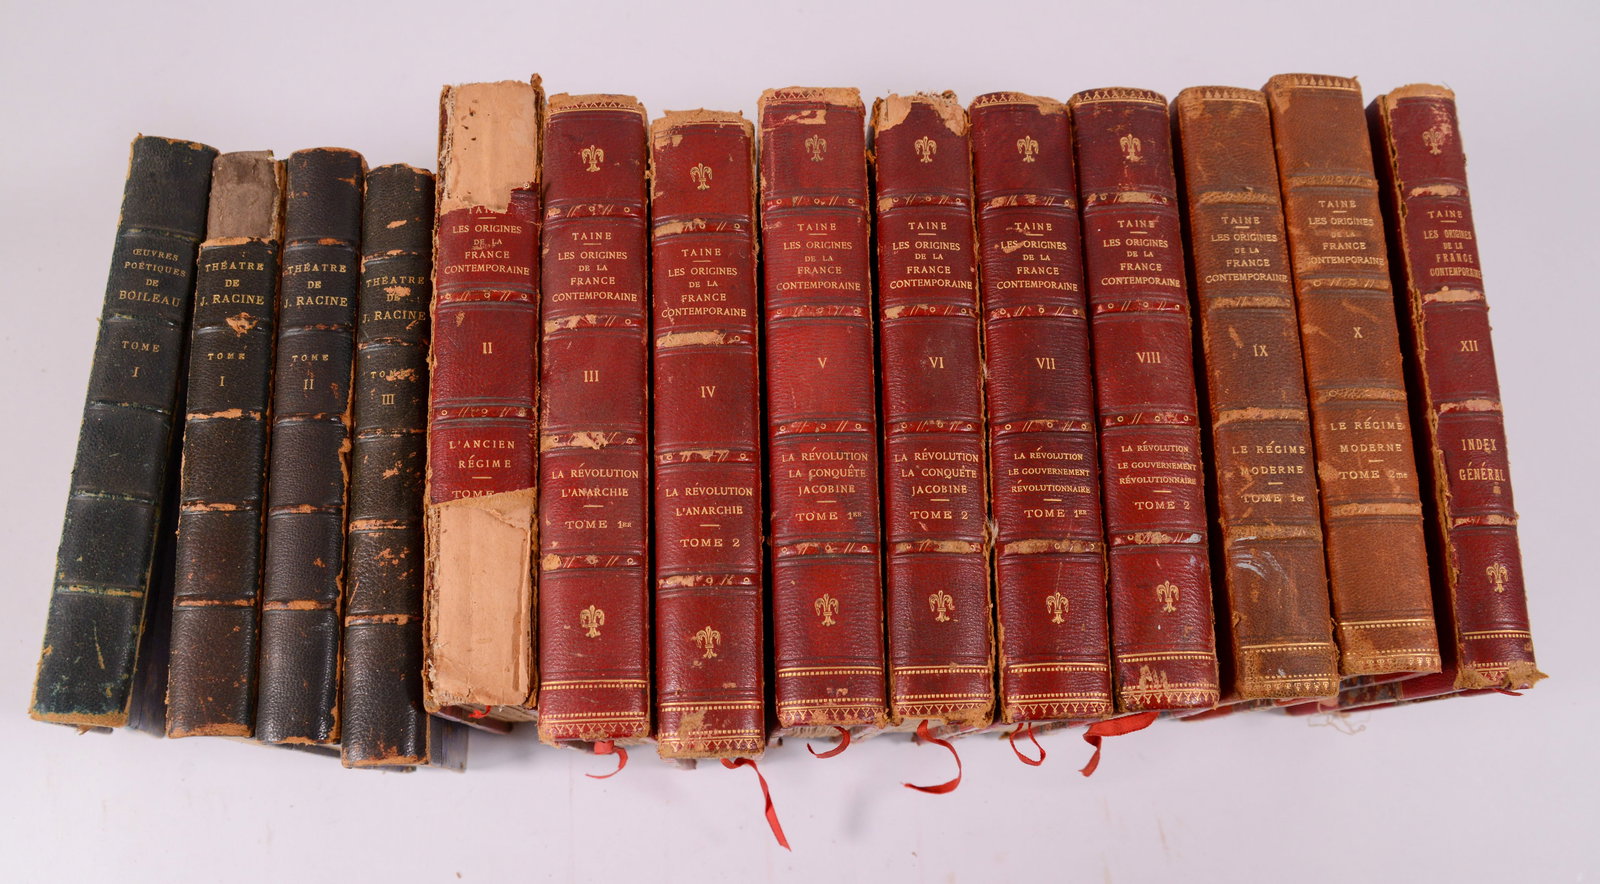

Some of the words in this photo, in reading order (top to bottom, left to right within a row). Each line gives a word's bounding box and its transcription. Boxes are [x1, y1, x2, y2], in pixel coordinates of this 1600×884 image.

[1318, 200, 1357, 208] TAINE
[1427, 210, 1463, 219] TAINE
[1117, 220, 1155, 228] TAINE
[1221, 216, 1261, 225] TAINE
[1308, 217, 1327, 225] LES
[1331, 217, 1374, 227] ORIGINES
[452, 225, 469, 234] LES
[474, 224, 522, 234] ORIGINES
[797, 223, 837, 232] TAINE
[908, 222, 947, 230] TAINE
[1014, 222, 1052, 231] TAINE
[572, 232, 612, 240] TAINE
[1211, 234, 1230, 242] LES
[1233, 233, 1278, 242] ORIGINES
[1424, 230, 1439, 239] LES
[1444, 230, 1472, 239] ORIGINES
[474, 238, 485, 246] DE
[784, 241, 800, 250] LES
[806, 241, 852, 249] ORIGINES
[892, 242, 909, 250] LES
[915, 241, 960, 251] ORIGINES
[1001, 241, 1018, 249] LES
[1023, 241, 1067, 250] ORIGINES
[1103, 239, 1121, 248] LES
[1126, 239, 1168, 248] ORIGINES
[1322, 242, 1367, 250] FRANCE
[132, 249, 179, 261] ŒUVRES
[465, 251, 510, 259] FRANCE
[558, 252, 574, 261] LES
[682, 248, 721, 257] TAINE
[1226, 259, 1271, 267] FRANCE
[1436, 253, 1473, 263] FRANCE
[124, 261, 187, 278] POÉTIQUES
[205, 261, 264, 272] THÉATRE
[288, 262, 347, 274] THÉATRE
[444, 264, 530, 276] CONTEMPORAINE
[797, 266, 842, 275] FRANCE
[907, 266, 951, 274] FRANCE
[1017, 266, 1060, 275] FRANCE
[1120, 263, 1162, 271] FRANCE
[668, 268, 685, 277] LES
[691, 267, 737, 276] ORIGINES
[146, 279, 159, 287] DE
[366, 275, 425, 287] THÉATRE
[570, 277, 615, 285] FRANCE
[1101, 277, 1181, 288] CONTEMPORAINE
[1206, 273, 1288, 283] CONTEMPORAINE
[225, 279, 240, 288] DE
[308, 281, 322, 289] DE
[776, 281, 861, 291] CONTEMPORAINE
[890, 279, 972, 290] CONTEMPORAINE
[997, 280, 1078, 292] CONTEMPORAINE
[119, 290, 181, 307] BOILEAU
[200, 296, 208, 306] J.
[213, 294, 264, 305] RACINE
[284, 299, 292, 308] J.
[296, 296, 348, 306] RACINE
[386, 294, 400, 302] DE
[552, 292, 637, 302] CONTEMPORAINE
[681, 293, 726, 303] FRANCE
[363, 314, 370, 323] J.
[374, 310, 426, 321] RACINE
[662, 307, 746, 318] CONTEMPORAINE
[1354, 327, 1363, 338] X
[122, 340, 160, 352] TOME
[482, 342, 493, 354] II
[1253, 345, 1268, 356] IX
[1460, 340, 1478, 352] XII
[818, 358, 827, 368] V
[929, 356, 944, 369] VI
[1136, 352, 1161, 364] VIII
[1036, 358, 1056, 369] VII
[132, 366, 140, 378] I
[584, 370, 599, 382] III
[220, 376, 225, 386] I
[303, 378, 314, 390] II
[700, 386, 716, 398] IV
[382, 394, 395, 405] III
[1330, 422, 1347, 431] LE
[1355, 417, 1404, 430] RÉGIME
[449, 440, 515, 449] L'ANCIEN
[1121, 445, 1133, 453] LA
[1137, 441, 1189, 453] RÉVOLUTION
[1232, 445, 1248, 454] LE
[1256, 441, 1306, 454] RÉGIME
[1340, 444, 1402, 453] MODERNE
[1461, 439, 1497, 451] INDEX
[782, 454, 795, 463] LA
[801, 447, 868, 461] RÉVOLUTION
[895, 454, 907, 462] LA
[914, 448, 979, 463] RÉVOLUTION
[1030, 446, 1083, 460] RÉVOLUTION
[458, 455, 511, 468] RÉGIME
[1131, 462, 1197, 471] GOUVERNEMENT
[552, 471, 564, 479] LA
[570, 463, 639, 479] RÉVOLUTION
[789, 470, 802, 478] LA
[809, 464, 866, 480] CONQUÊTE
[902, 469, 914, 477] LA
[922, 466, 977, 479] CONQUÊTE
[1022, 468, 1090, 477] GOUVERNEMENT
[1241, 466, 1304, 475] MODERNE
[1339, 471, 1380, 480] TOME
[1459, 462, 1506, 481] GÉNÉRAL
[1119, 474, 1197, 485] RÉVOLUTIONNAIRE
[666, 488, 678, 497] LA
[685, 482, 753, 496] RÉVOLUTION
[799, 484, 855, 497] JACOBINE
[912, 484, 968, 496] JACOBINE
[1012, 480, 1091, 494] RÉVOLUTIONNAIRE
[562, 488, 629, 497] L'ANARCHIE
[1241, 494, 1282, 503] TOME
[1135, 501, 1175, 510] TOME
[1184, 500, 1190, 510] 2
[676, 506, 743, 517] L'ANARCHIE
[796, 512, 838, 521] TOME
[910, 511, 952, 520] TOME
[962, 511, 968, 520] 2
[1024, 510, 1066, 518] TOME
[565, 520, 608, 529] TOME
[680, 538, 723, 548] TOME
[733, 538, 740, 548] 2
